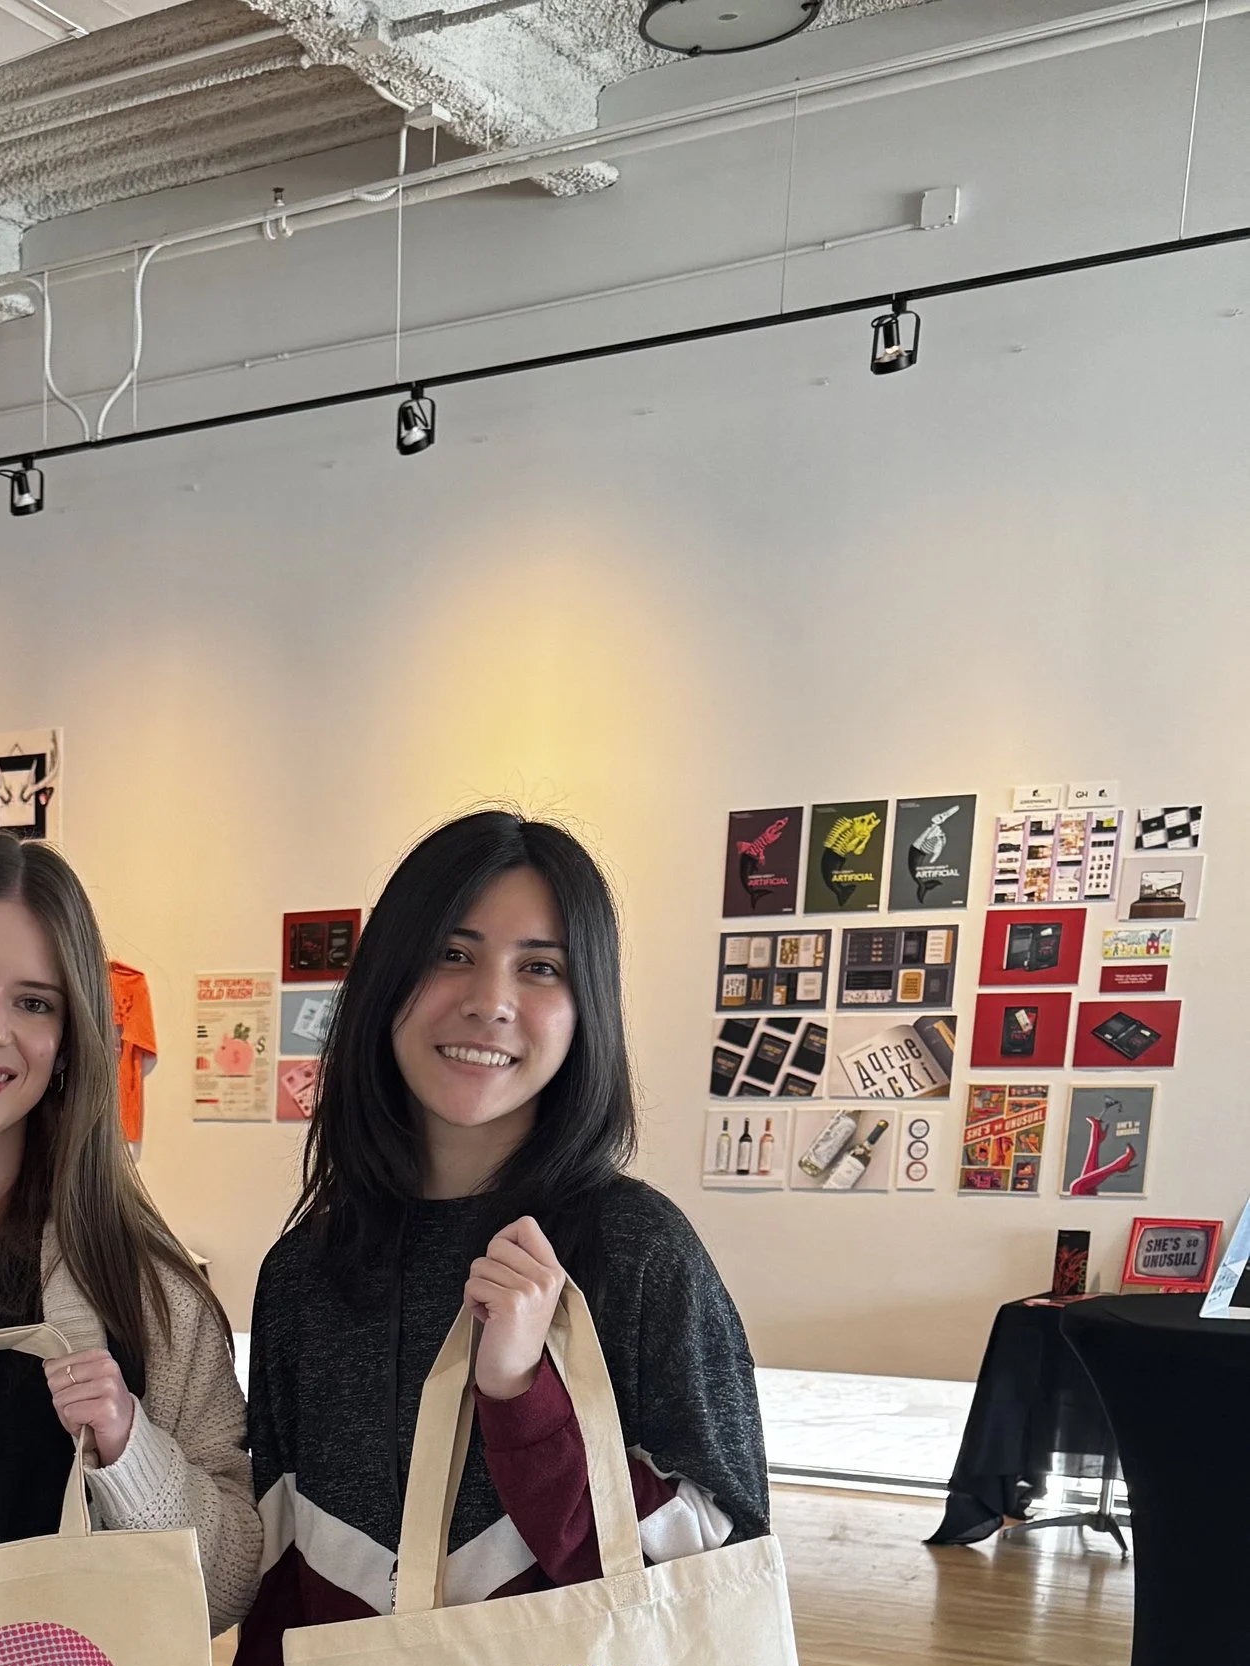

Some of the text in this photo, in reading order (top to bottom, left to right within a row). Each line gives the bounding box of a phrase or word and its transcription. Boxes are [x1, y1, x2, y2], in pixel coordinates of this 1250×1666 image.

[831, 871, 875, 882] ARTIFICIAL
[915, 868, 960, 879] ARTIFICIAL
[748, 877, 789, 887] ARTIFICIAL
[197, 988, 224, 1000] GOLD
[1145, 1236, 1182, 1253] SHE'S
[1142, 1252, 1198, 1269] UNUSUAL
